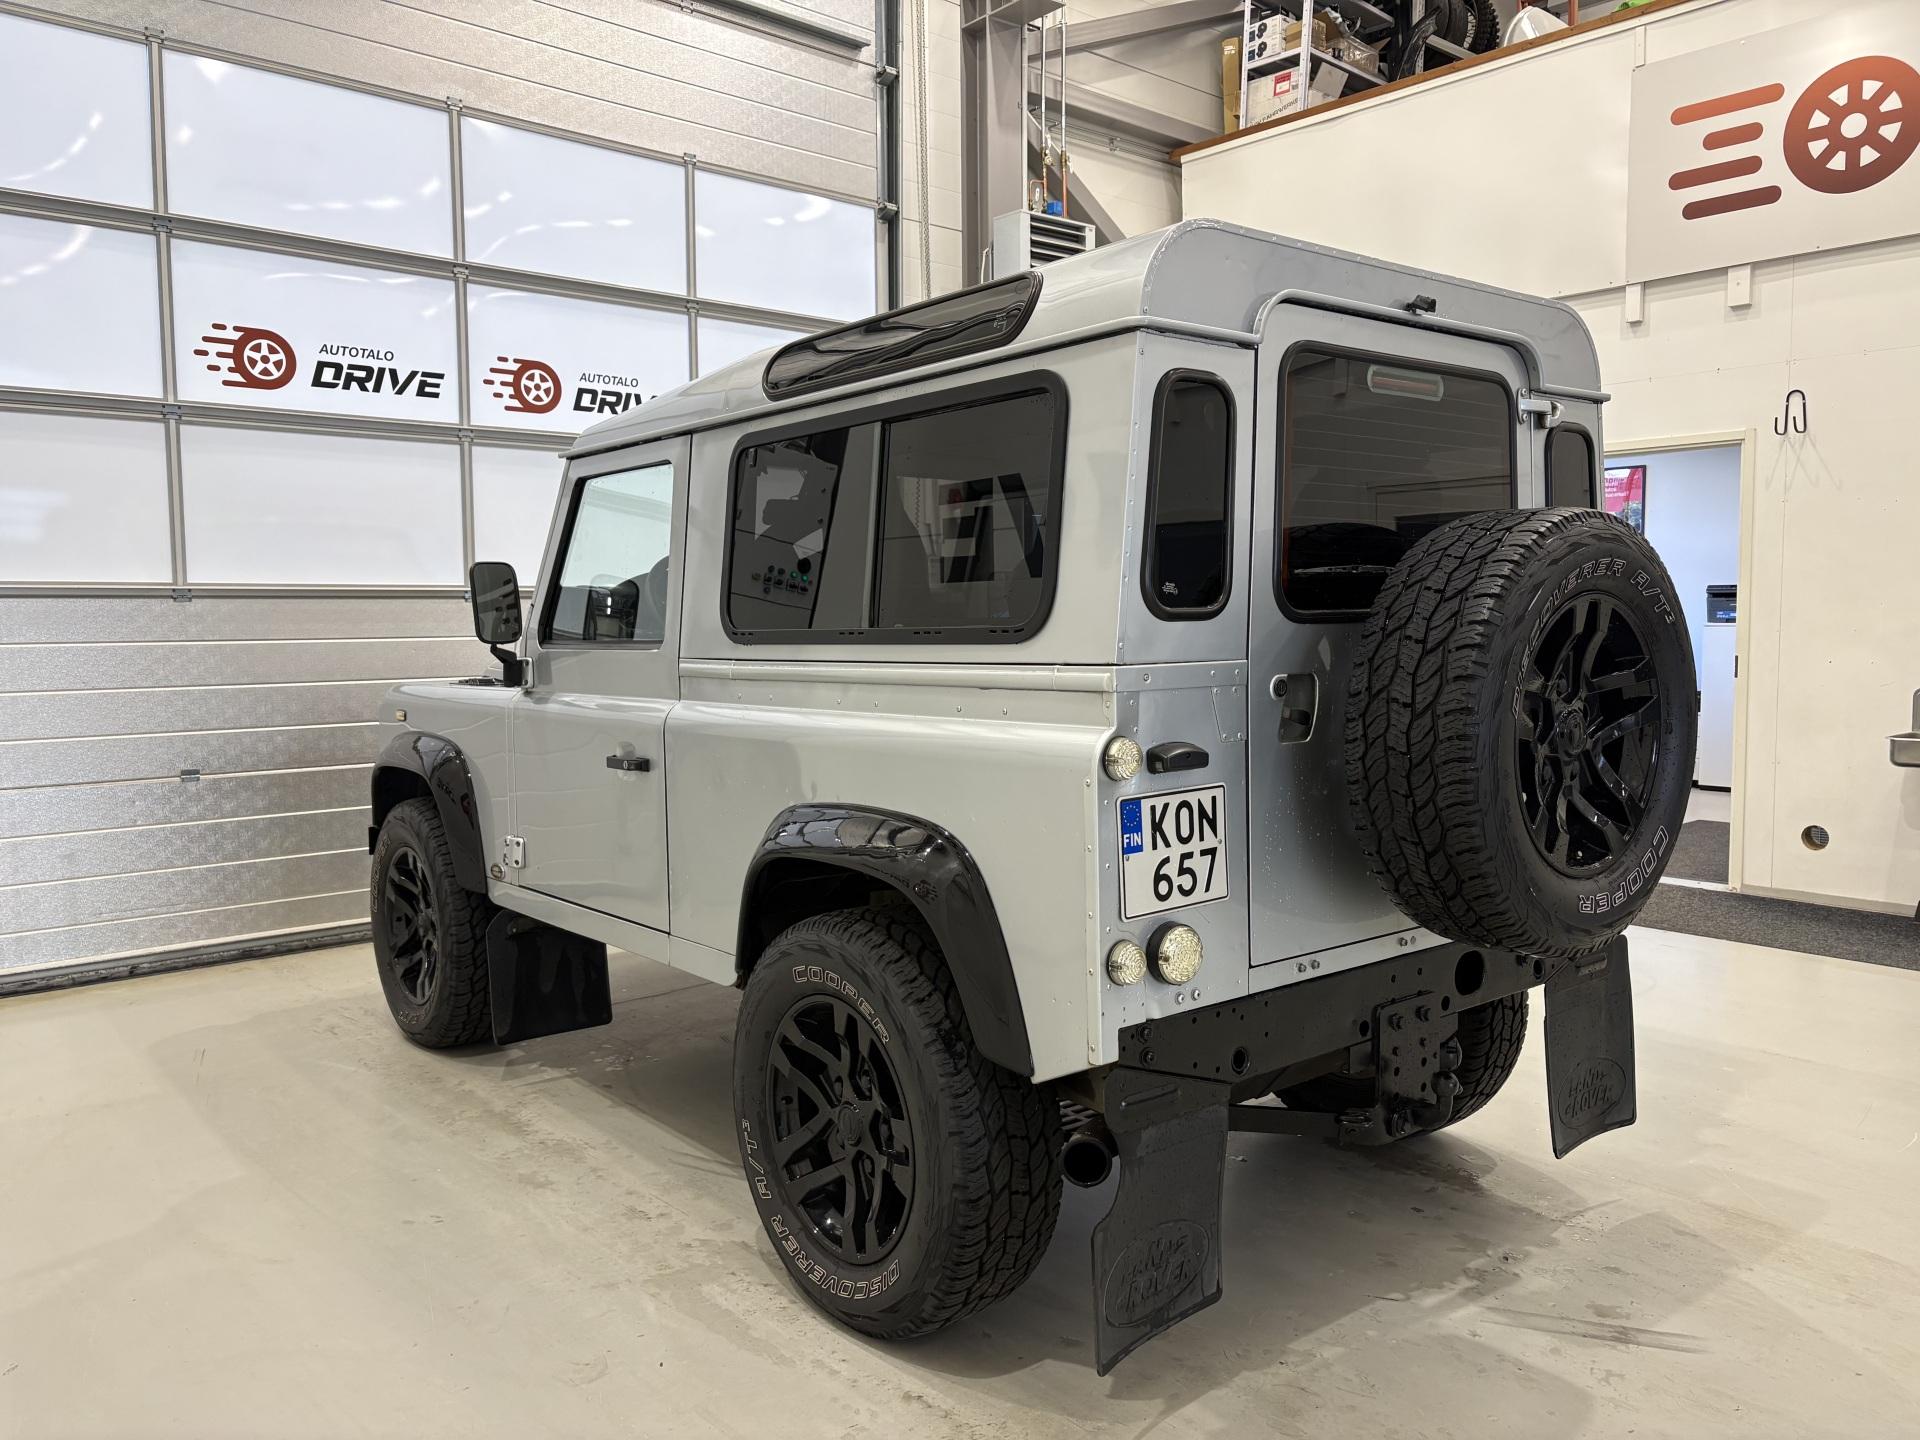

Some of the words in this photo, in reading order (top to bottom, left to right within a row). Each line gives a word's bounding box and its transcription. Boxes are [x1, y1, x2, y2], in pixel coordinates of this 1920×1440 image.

[311, 360, 445, 399] DRIVE
[319, 343, 394, 361] AUTOTALO
[579, 372, 639, 388] AUTOTALO
[1123, 832, 1142, 848] FIN
[1150, 795, 1217, 851] KON
[1153, 846, 1218, 902] 657
[1579, 825, 1668, 914] COOPER
[793, 965, 889, 1045] COOPER
[771, 1214, 899, 1299] DISCOVERER
